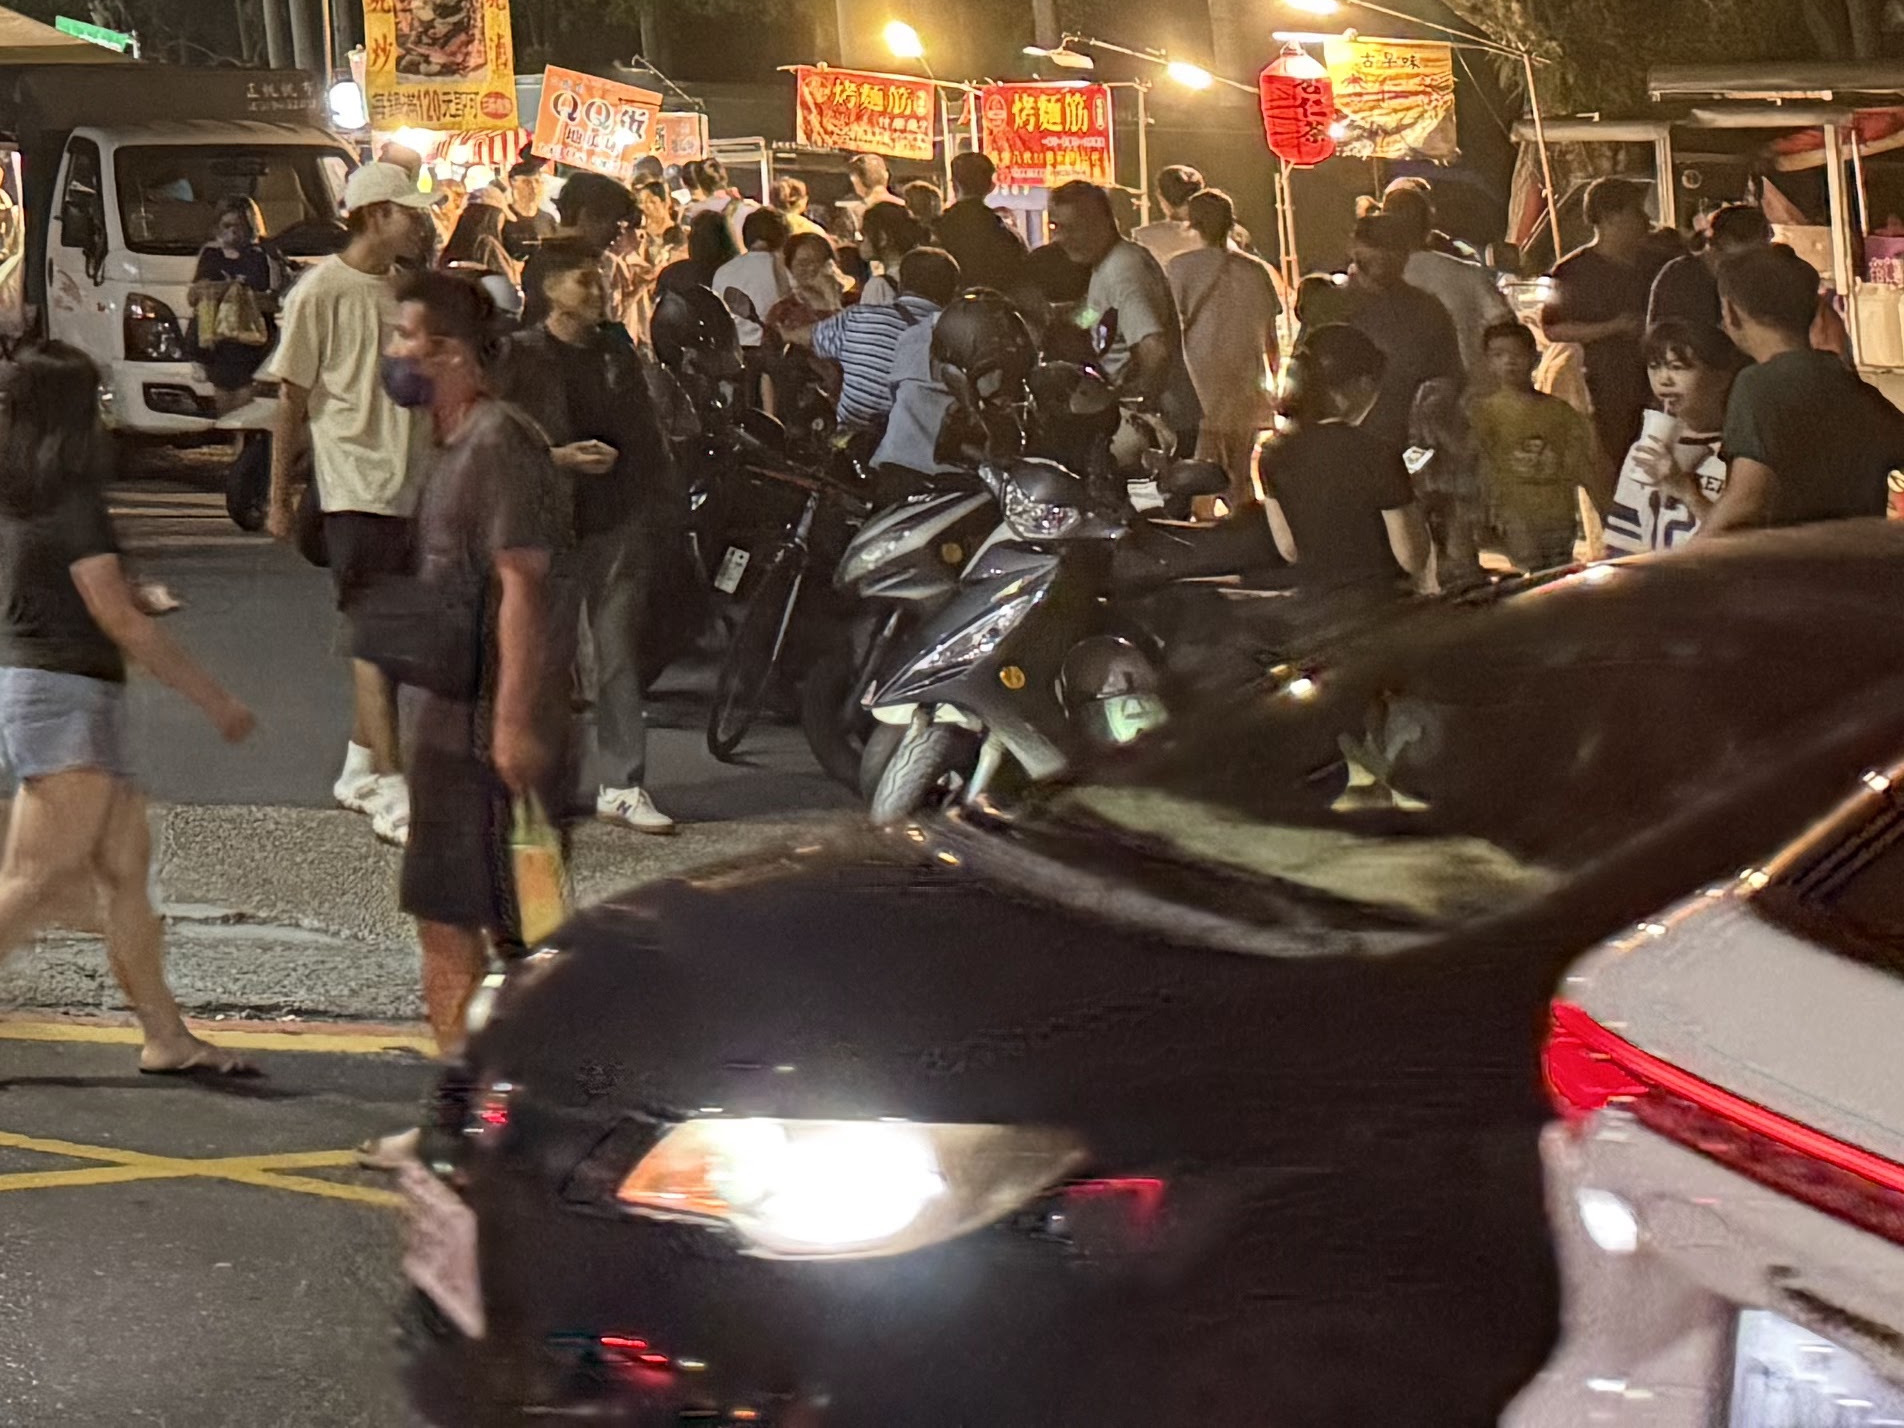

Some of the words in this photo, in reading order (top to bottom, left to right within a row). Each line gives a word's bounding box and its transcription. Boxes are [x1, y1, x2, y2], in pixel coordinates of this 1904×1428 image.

[1360, 51, 1421, 70] 古早味
[1011, 91, 1089, 133] 烤麵筋
